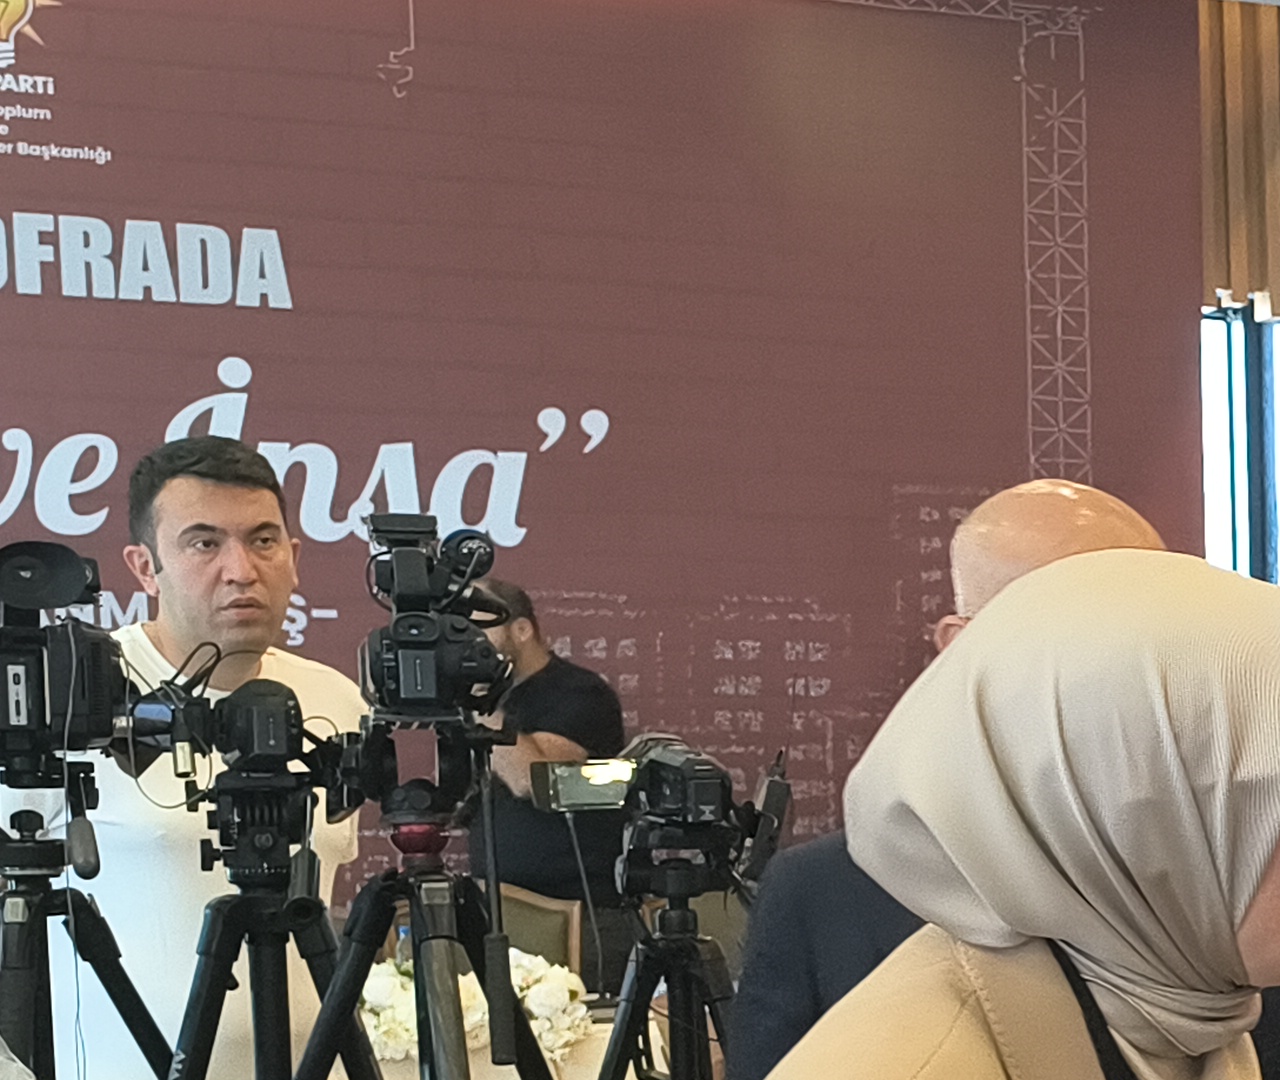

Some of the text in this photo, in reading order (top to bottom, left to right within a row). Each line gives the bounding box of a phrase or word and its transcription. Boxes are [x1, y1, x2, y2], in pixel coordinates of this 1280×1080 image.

[0, 73, 54, 95] ARTİ
[16, 141, 112, 165] Başkanlığı
[0, 211, 293, 310] FRADA
